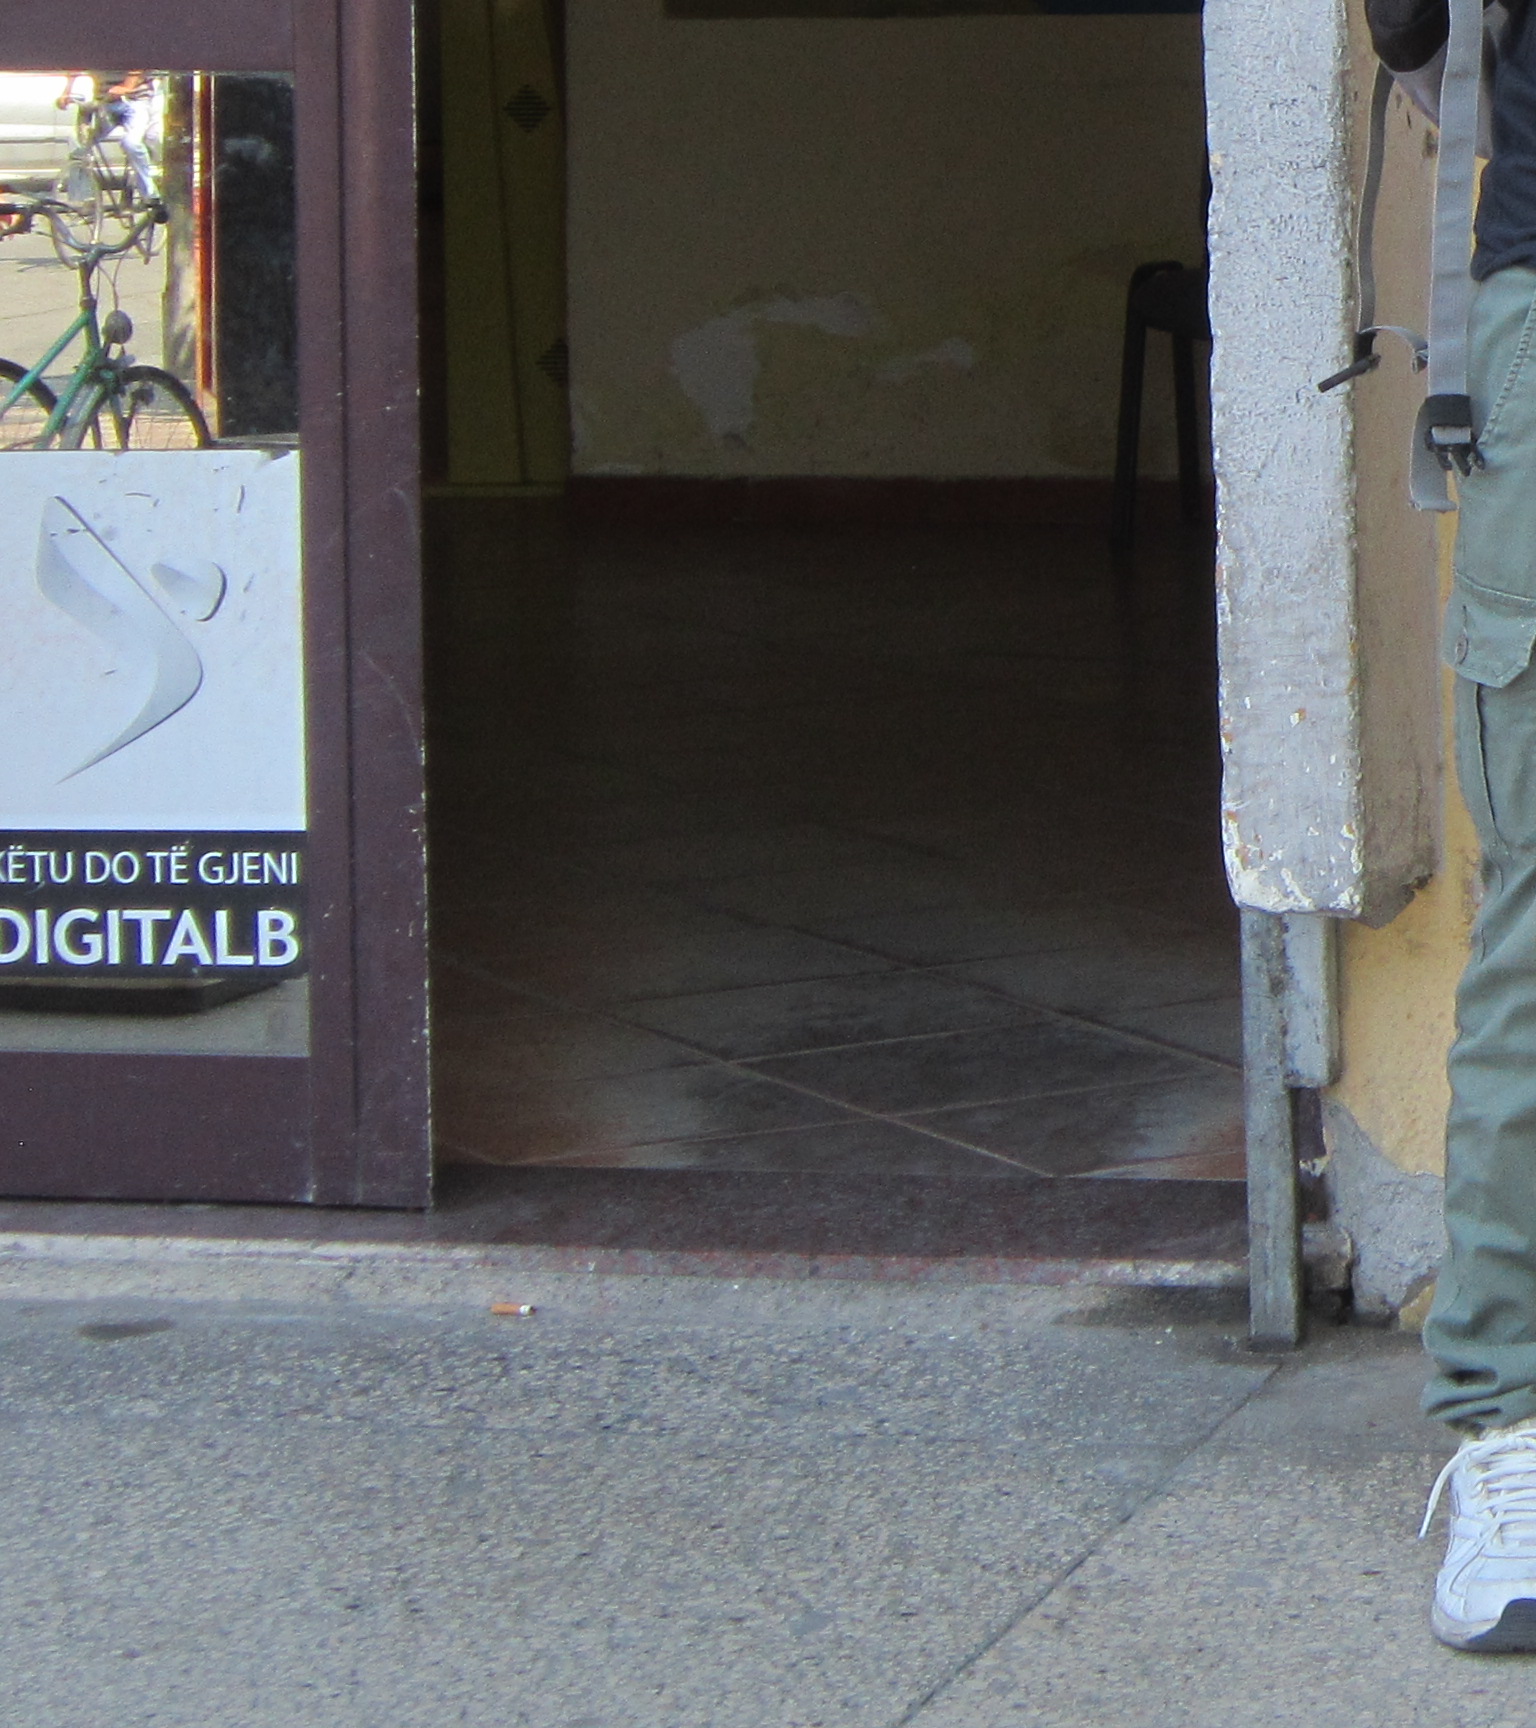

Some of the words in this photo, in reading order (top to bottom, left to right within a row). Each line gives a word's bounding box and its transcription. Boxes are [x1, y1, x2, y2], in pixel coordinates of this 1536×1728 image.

[84, 850, 141, 886] DO
[146, 844, 188, 885] TË
[199, 851, 300, 886] GJENI
[0, 907, 302, 967] DIGITALB
